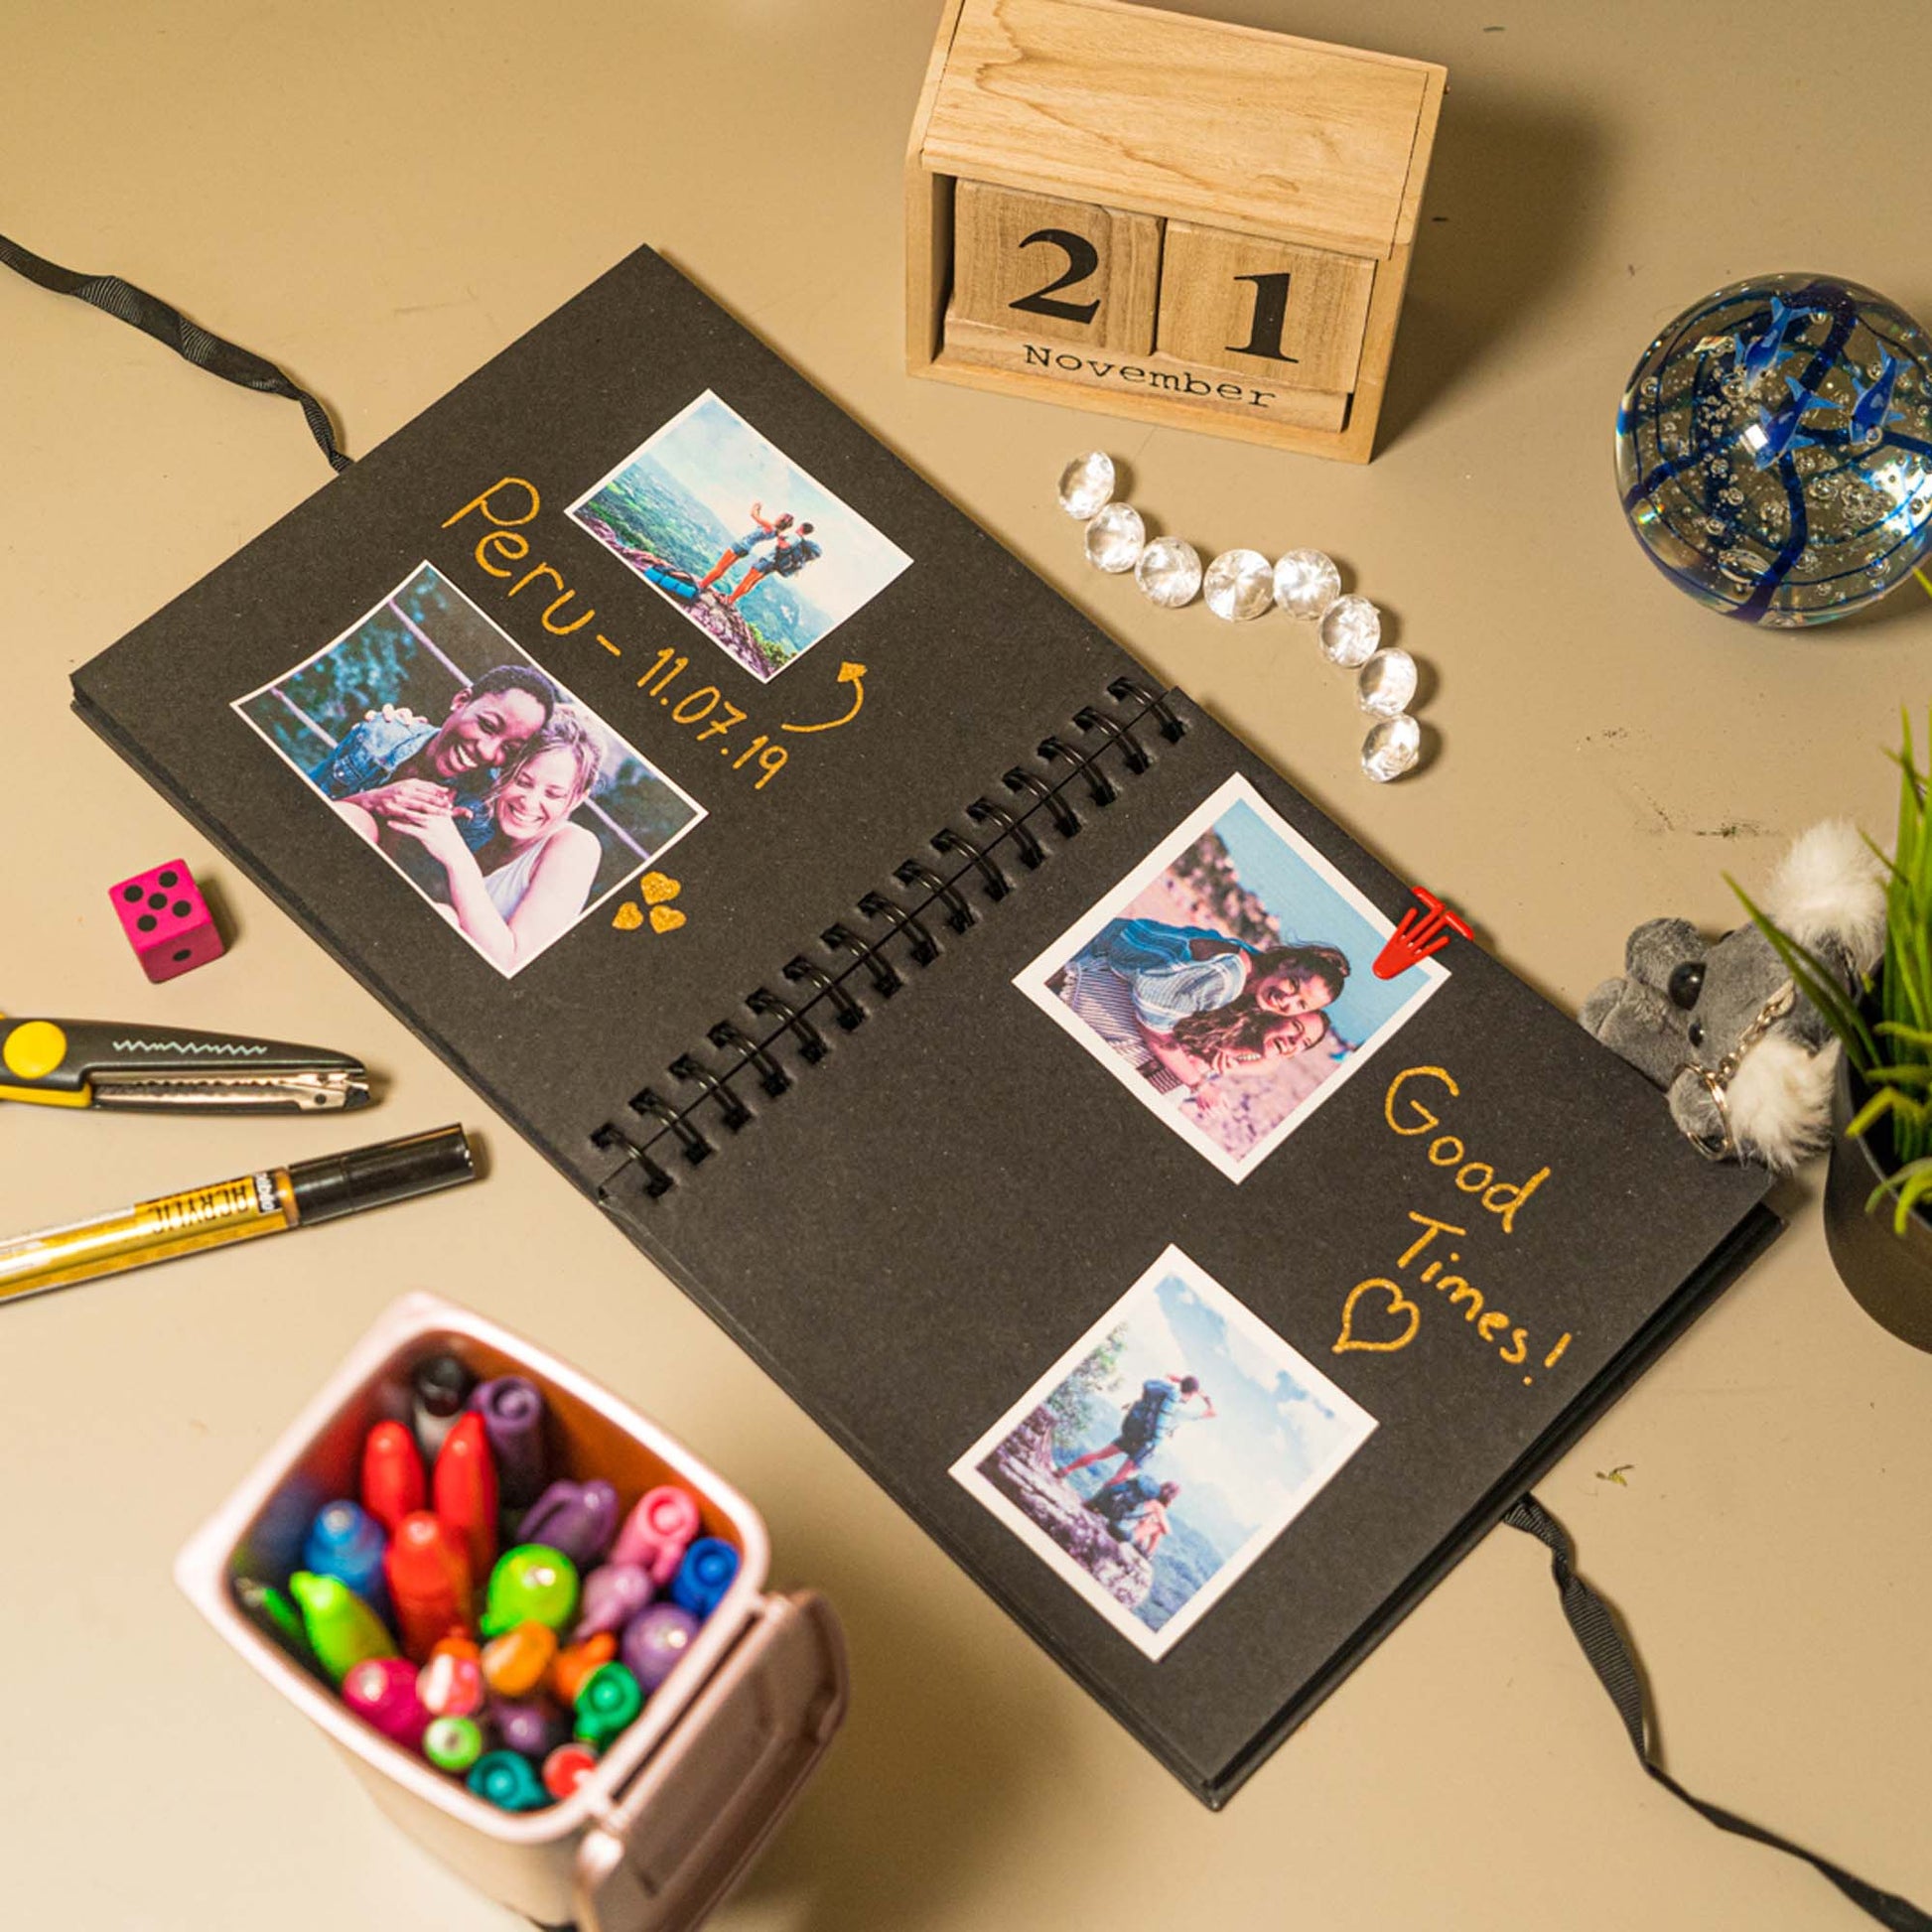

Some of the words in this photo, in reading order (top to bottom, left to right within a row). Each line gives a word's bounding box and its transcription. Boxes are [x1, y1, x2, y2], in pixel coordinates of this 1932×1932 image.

[1009, 228, 1101, 326] 2
[1225, 272, 1299, 364] 1
[1023, 344, 1277, 409] November
[441, 477, 596, 635] Peru
[636, 647, 788, 790] 11.07.19
[148, 1184, 249, 1234] ACRYLIC
[1384, 1065, 1551, 1234] Good
[1397, 1210, 1573, 1386] Times!
